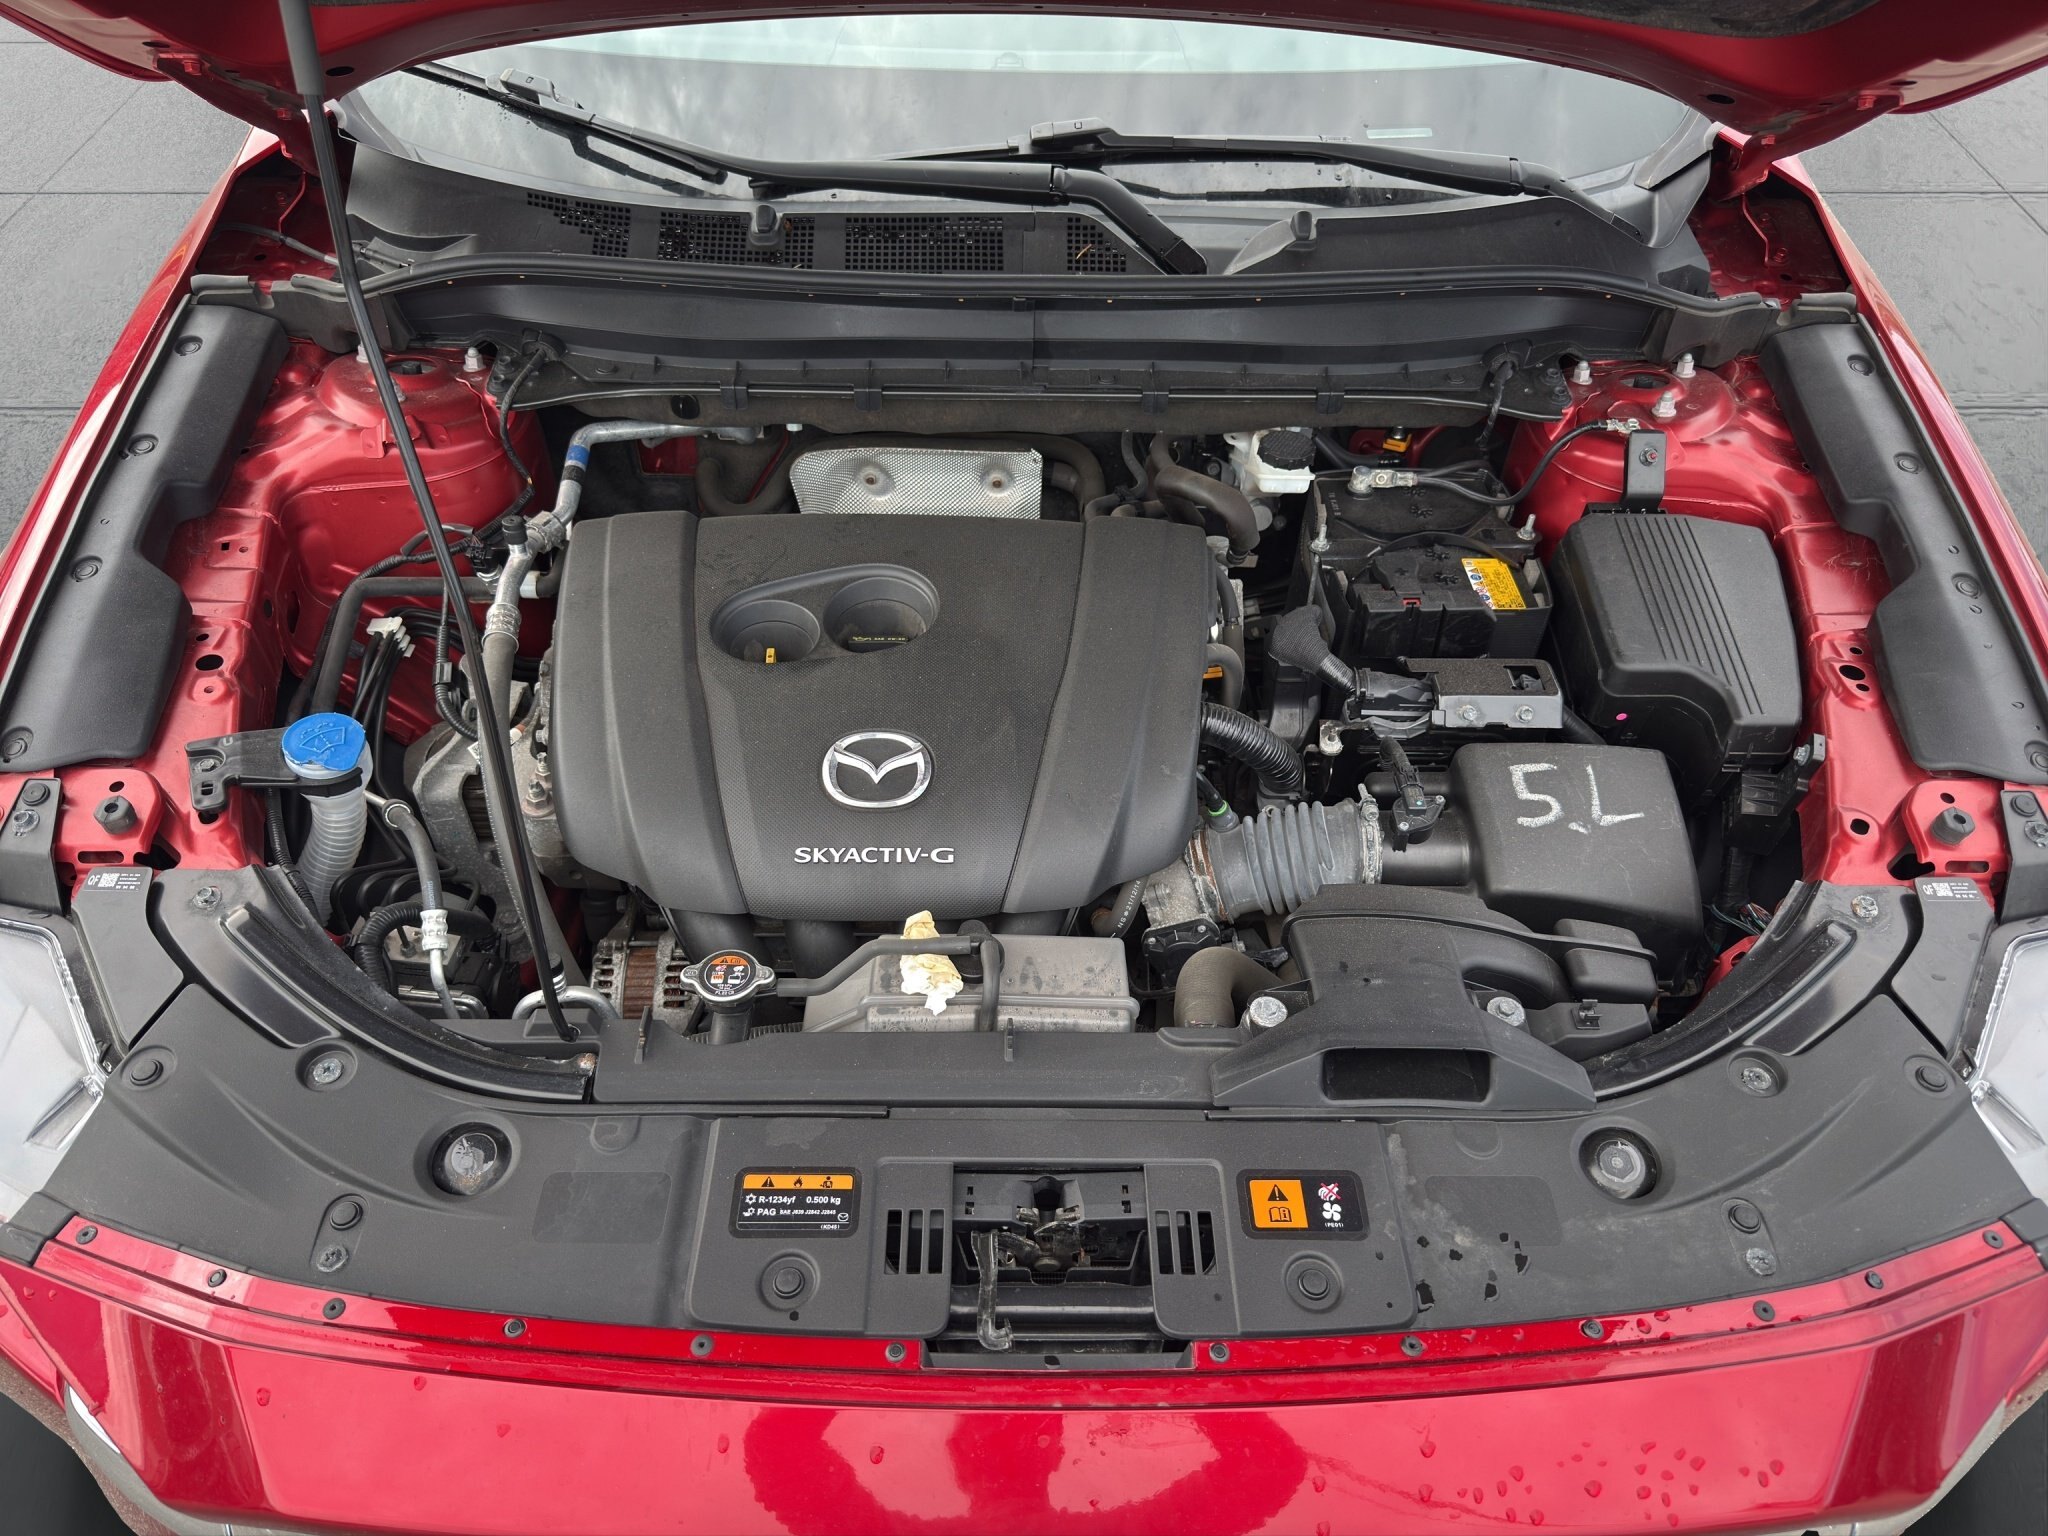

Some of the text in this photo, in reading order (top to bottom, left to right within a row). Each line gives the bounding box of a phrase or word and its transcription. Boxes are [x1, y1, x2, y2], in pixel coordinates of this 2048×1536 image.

[794, 847, 954, 864] SKYACTIV-G
[758, 1195, 841, 1206] R-1234yf 0.500 kg
[756, 1207, 777, 1216] PAG
